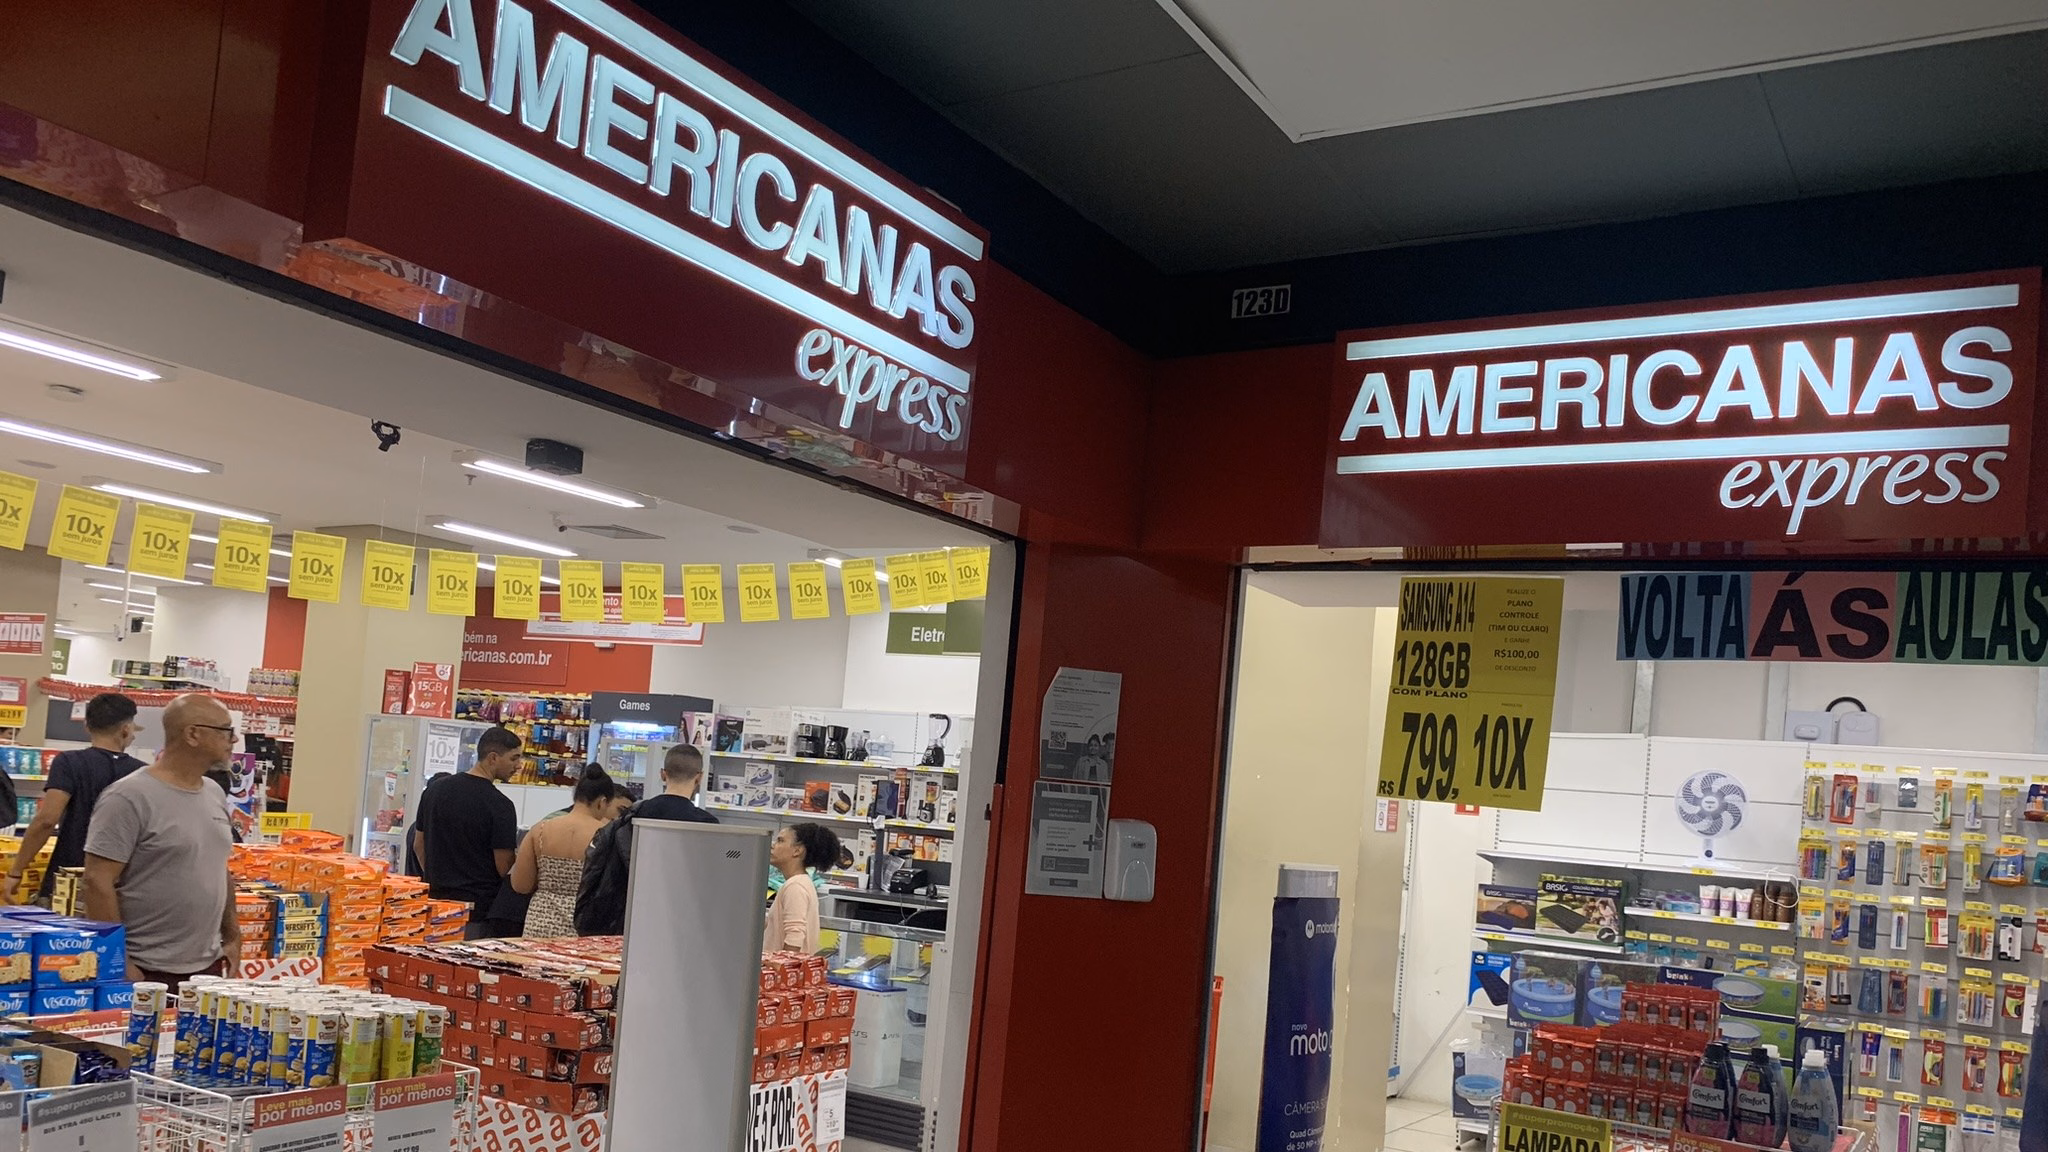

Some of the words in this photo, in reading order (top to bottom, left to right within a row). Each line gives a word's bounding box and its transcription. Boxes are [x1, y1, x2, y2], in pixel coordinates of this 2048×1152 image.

[391, 0, 975, 348] AMERICANAS
[1233, 287, 1290, 317] 123D
[795, 328, 967, 442] express
[1340, 325, 2014, 441] AMERICANAS
[1718, 451, 2008, 535] express
[66, 514, 105, 538] 10x
[62, 531, 80, 541] sem
[142, 531, 181, 554] 10x
[140, 548, 156, 556] sem
[225, 545, 262, 566] 10x
[223, 562, 240, 570] sem
[299, 557, 335, 577] 10x
[957, 565, 980, 580] 10x
[371, 565, 405, 586] 10x
[436, 574, 469, 592] 10x
[893, 574, 918, 589] 10x
[925, 570, 948, 585] 10x
[370, 582, 386, 590] sem
[502, 579, 534, 597] 10x
[567, 583, 598, 599] 10x
[629, 584, 658, 601] 10x
[690, 586, 718, 601] 10x
[745, 585, 772, 600] 10x
[796, 583, 822, 598] 10x
[848, 579, 874, 594] 10x
[1401, 581, 1454, 632] SAMSUNG
[1454, 581, 1476, 632] A14
[1507, 599, 1534, 607] PLANO
[1499, 611, 1540, 619] CONTROLE
[1621, 574, 1746, 659] VOLTA
[1751, 573, 1890, 660] ÁS
[1898, 571, 2048, 663] AULAS
[1488, 624, 1506, 632] (TIM
[1521, 625, 1549, 634] CLARO)
[486, 634, 497, 644] na
[1494, 649, 1540, 659] R$100,00
[1396, 640, 1471, 689] 128GB
[417, 681, 443, 692] 15GB
[1392, 687, 1421, 697] COM
[1425, 690, 1468, 699] PLANO
[619, 699, 651, 711] Games
[429, 740, 456, 759] 10x
[1378, 780, 1395, 796] R$
[1397, 711, 1459, 800] 799,
[1473, 714, 1534, 791] 10X
[1545, 882, 1566, 892] BASIC
[1291, 1023, 1308, 1031] novo
[1290, 1027, 1328, 1056] moto
[379, 1093, 403, 1108] por
[407, 1085, 452, 1102] menos
[380, 1086, 403, 1096] Leve
[404, 1081, 427, 1092] mais
[38, 1090, 127, 1117] #superpromoção
[259, 1101, 285, 1113] Leve
[288, 1096, 313, 1109] mais
[259, 1110, 285, 1126] por
[291, 1099, 342, 1118] menos
[762, 1090, 770, 1152] 5
[770, 1086, 796, 1150] POR:
[43, 1126, 56, 1135] BIS
[57, 1121, 78, 1130] XTRA
[95, 1111, 122, 1121] LACTA
[1512, 1111, 1600, 1133] #superpromoção
[1289, 1129, 1307, 1139] Quad
[1296, 1142, 1305, 1151] 50
